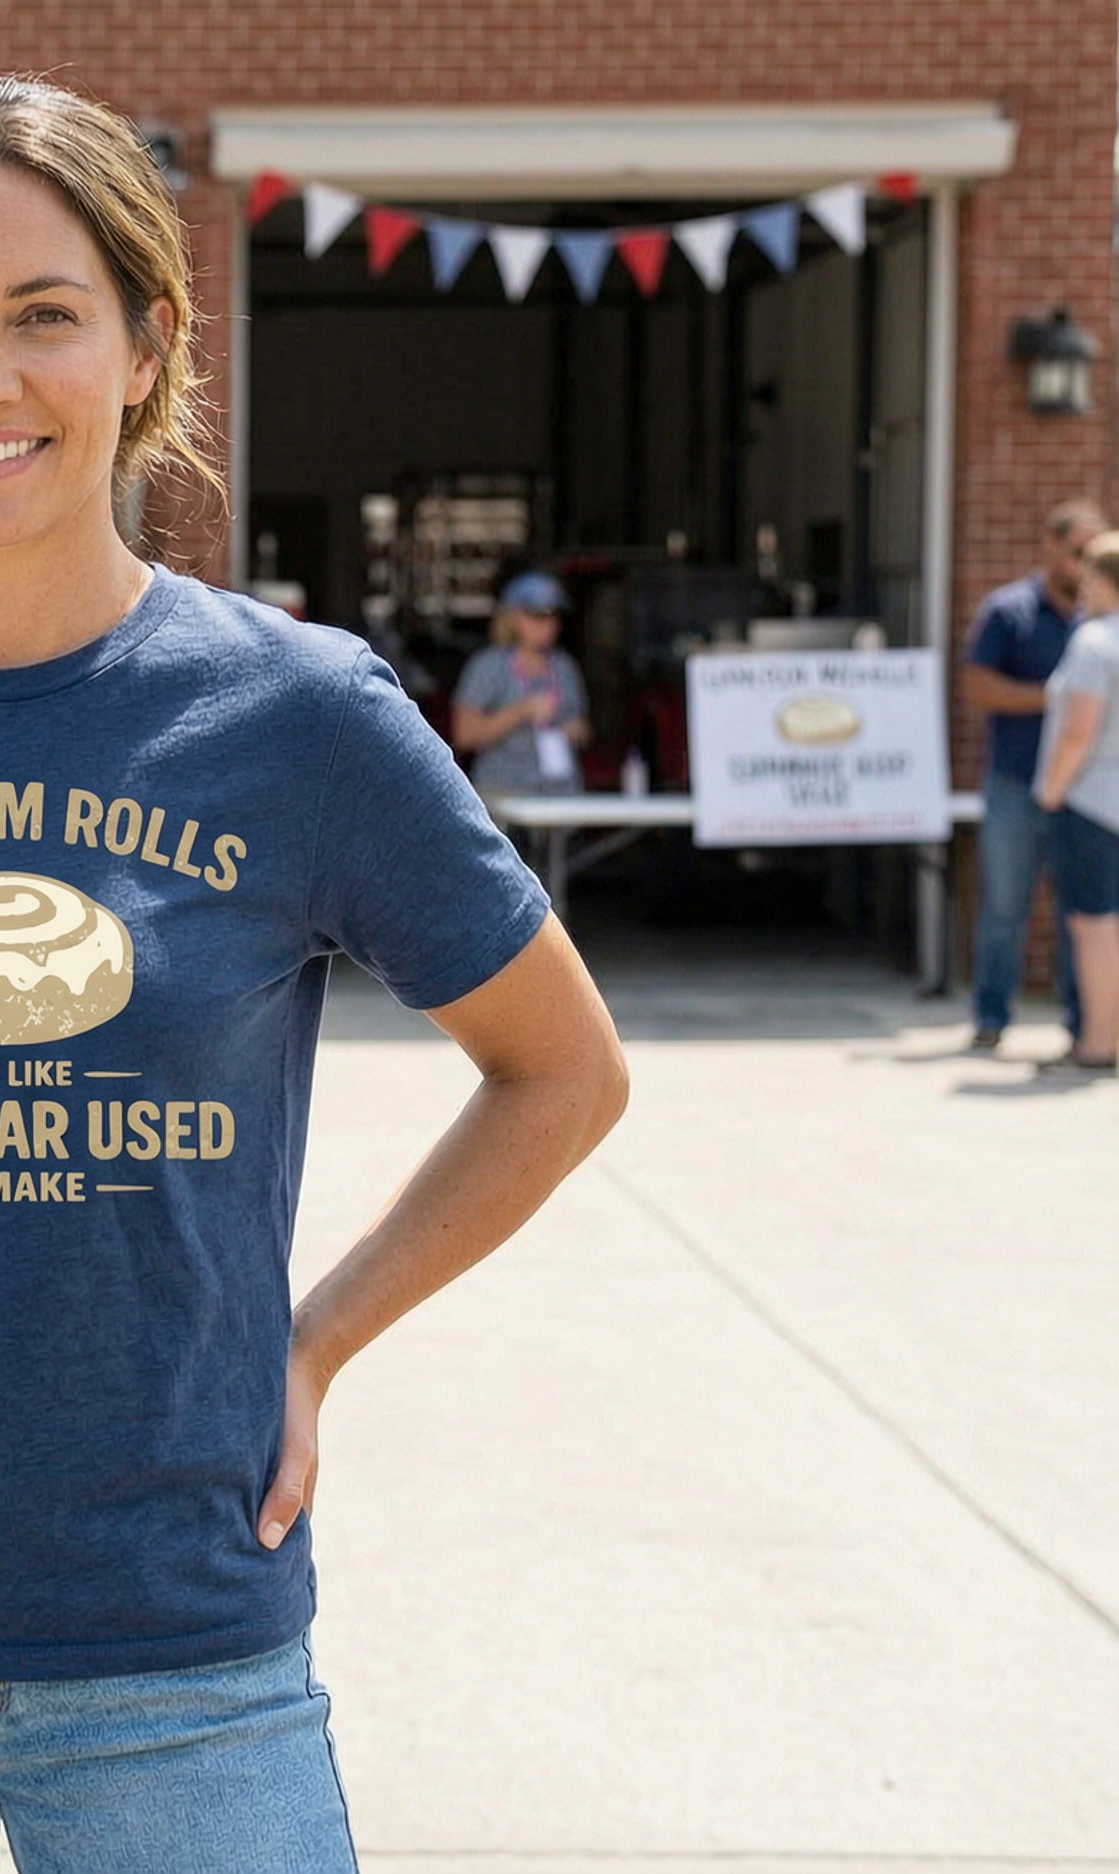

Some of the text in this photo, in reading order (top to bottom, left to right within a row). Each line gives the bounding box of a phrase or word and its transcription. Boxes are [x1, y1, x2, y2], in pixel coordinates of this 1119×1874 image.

[63, 788, 247, 892] ROLLS
[8, 1061, 73, 1087] LIKE
[88, 1101, 236, 1160] USED
